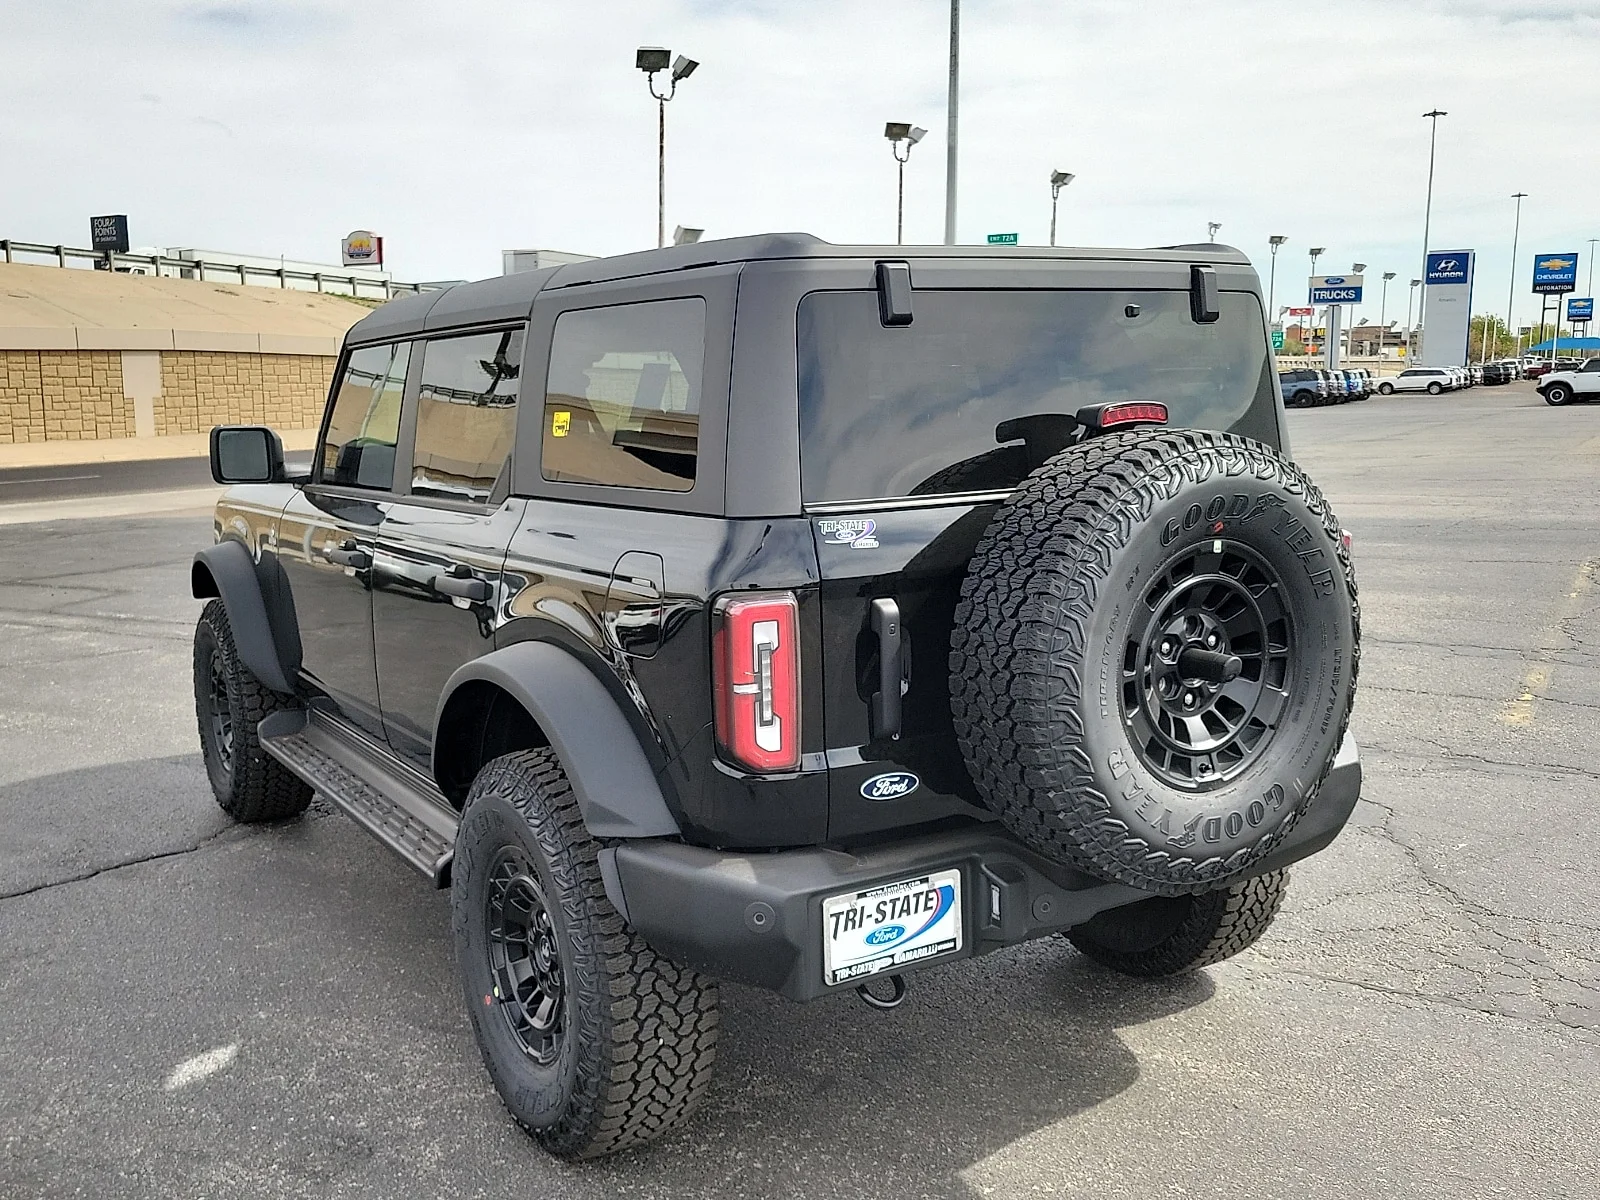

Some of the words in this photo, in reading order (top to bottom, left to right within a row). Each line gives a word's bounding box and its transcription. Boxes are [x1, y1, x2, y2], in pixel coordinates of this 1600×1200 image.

[95, 226, 117, 236] POINTS
[1428, 271, 1465, 279] HYUNDAI
[1314, 289, 1356, 300] TRUCKS
[819, 520, 867, 535] TRI-STATE
[872, 776, 909, 797] Ford
[829, 888, 938, 941] TRI-STATE
[872, 927, 899, 944] Ford
[834, 960, 874, 982] TRI-STATE
